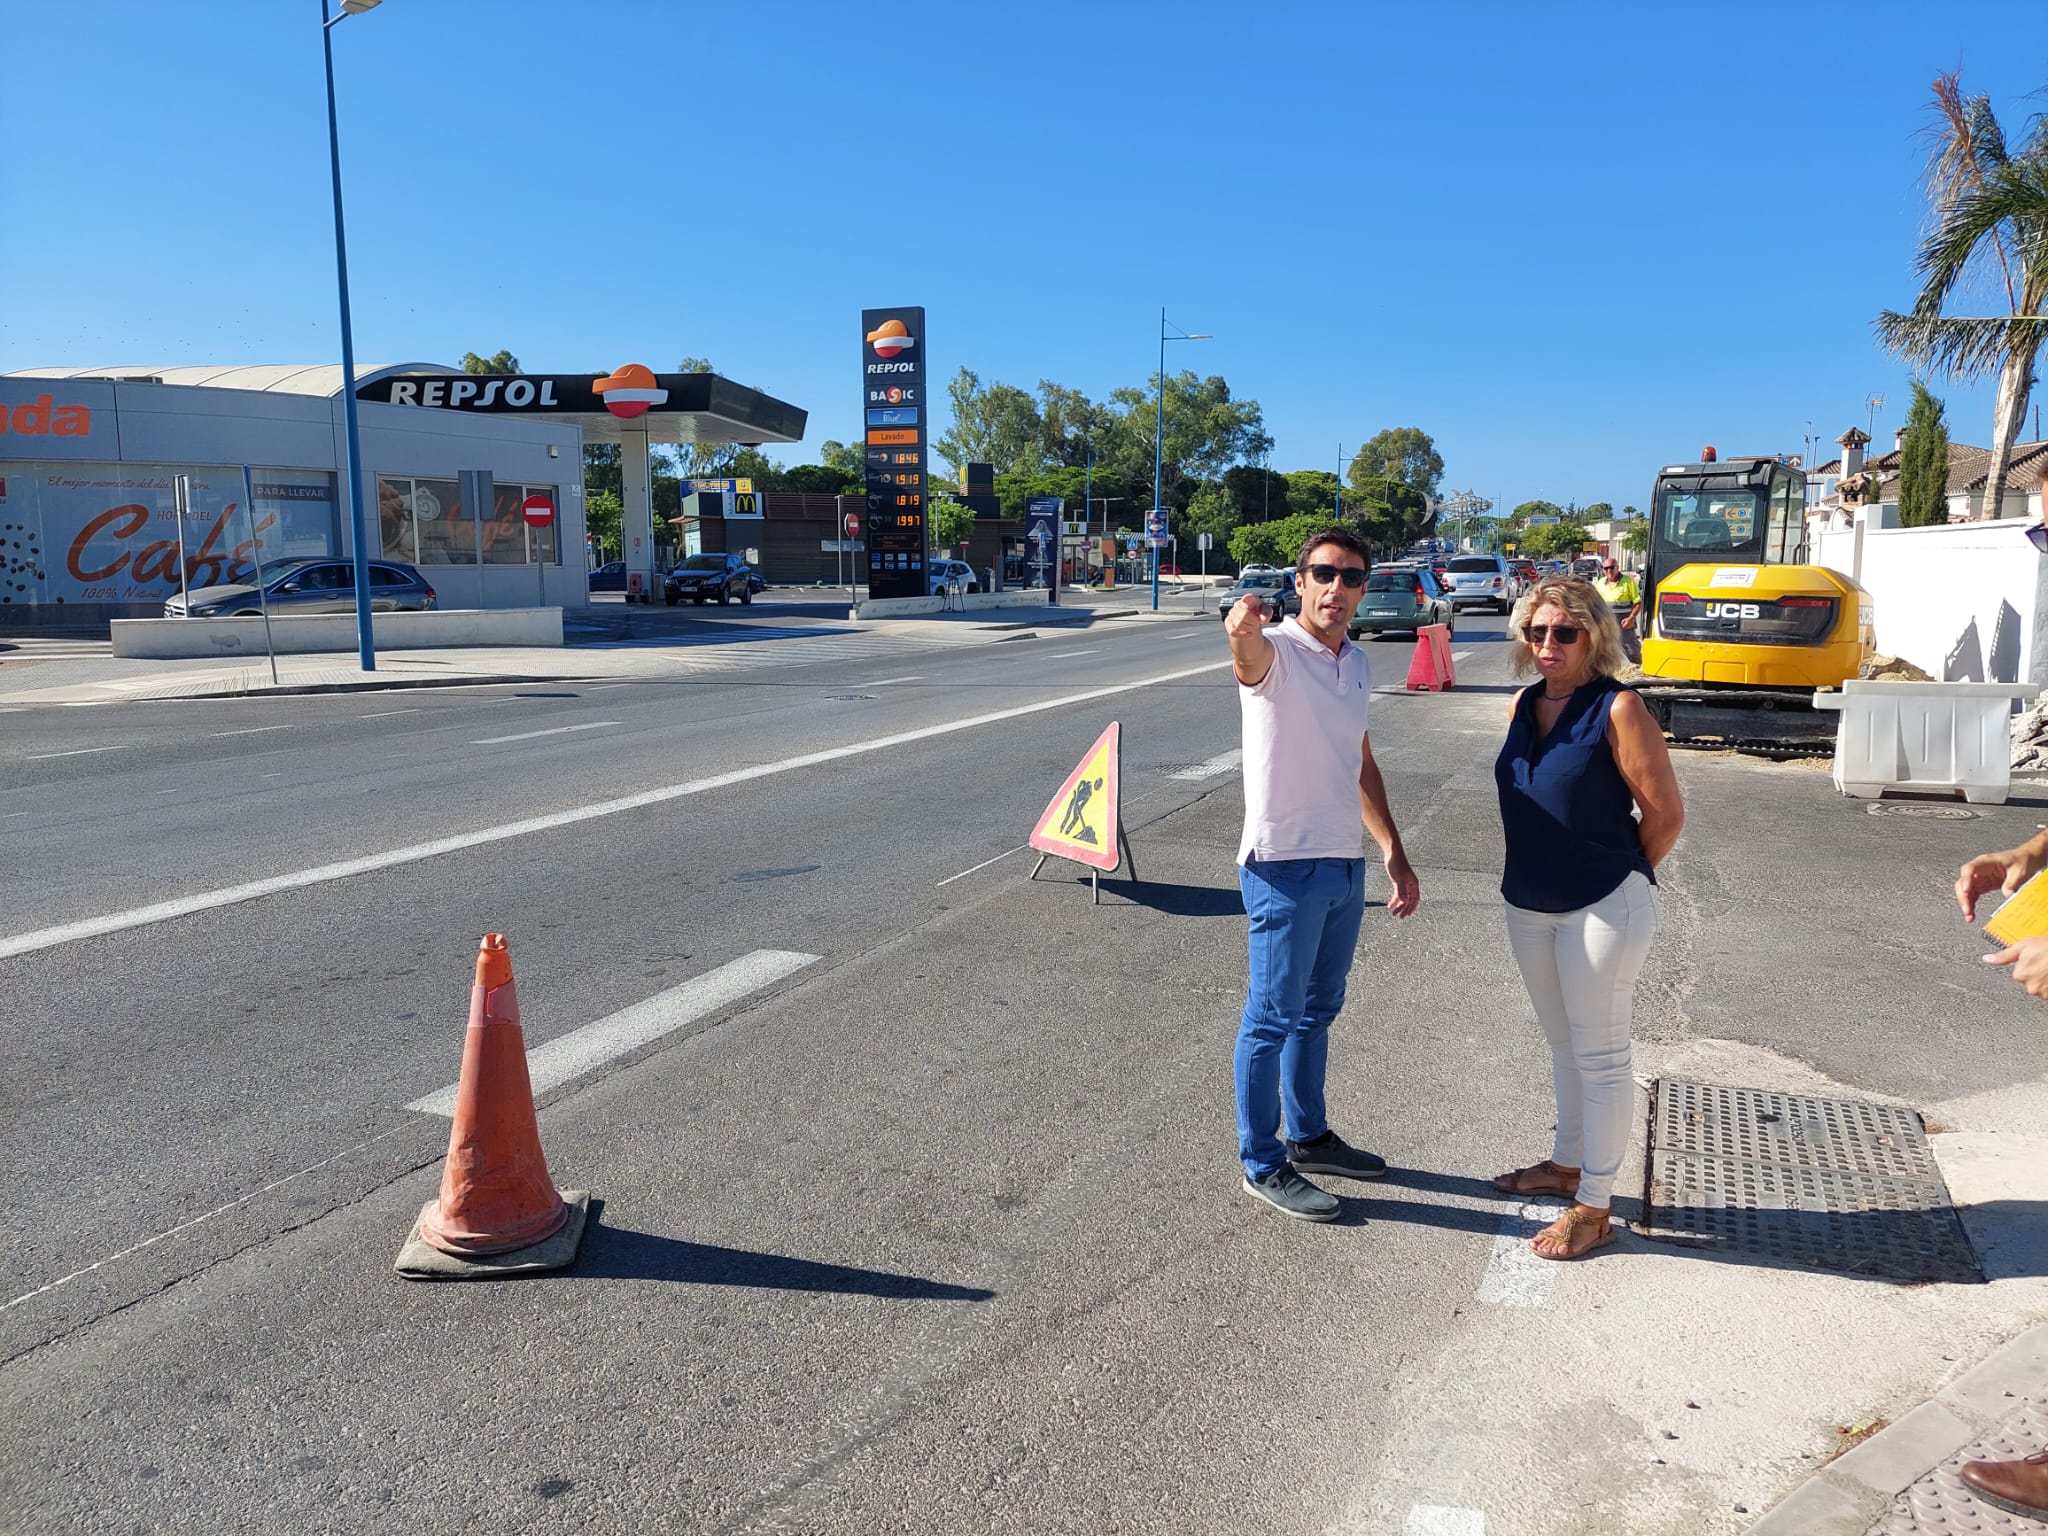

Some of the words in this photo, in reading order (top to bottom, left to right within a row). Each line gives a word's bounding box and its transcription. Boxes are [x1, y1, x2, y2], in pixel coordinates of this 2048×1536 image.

[867, 362, 915, 374] REPSOL
[390, 380, 558, 407] REPSOL
[870, 387, 914, 404] BASIC
[256, 487, 286, 497] PARA
[288, 487, 326, 497] LLEVAR
[191, 511, 213, 521] DEL
[67, 503, 276, 592] Café
[81, 586, 117, 598] 100%
[1706, 602, 1760, 619] JCB
